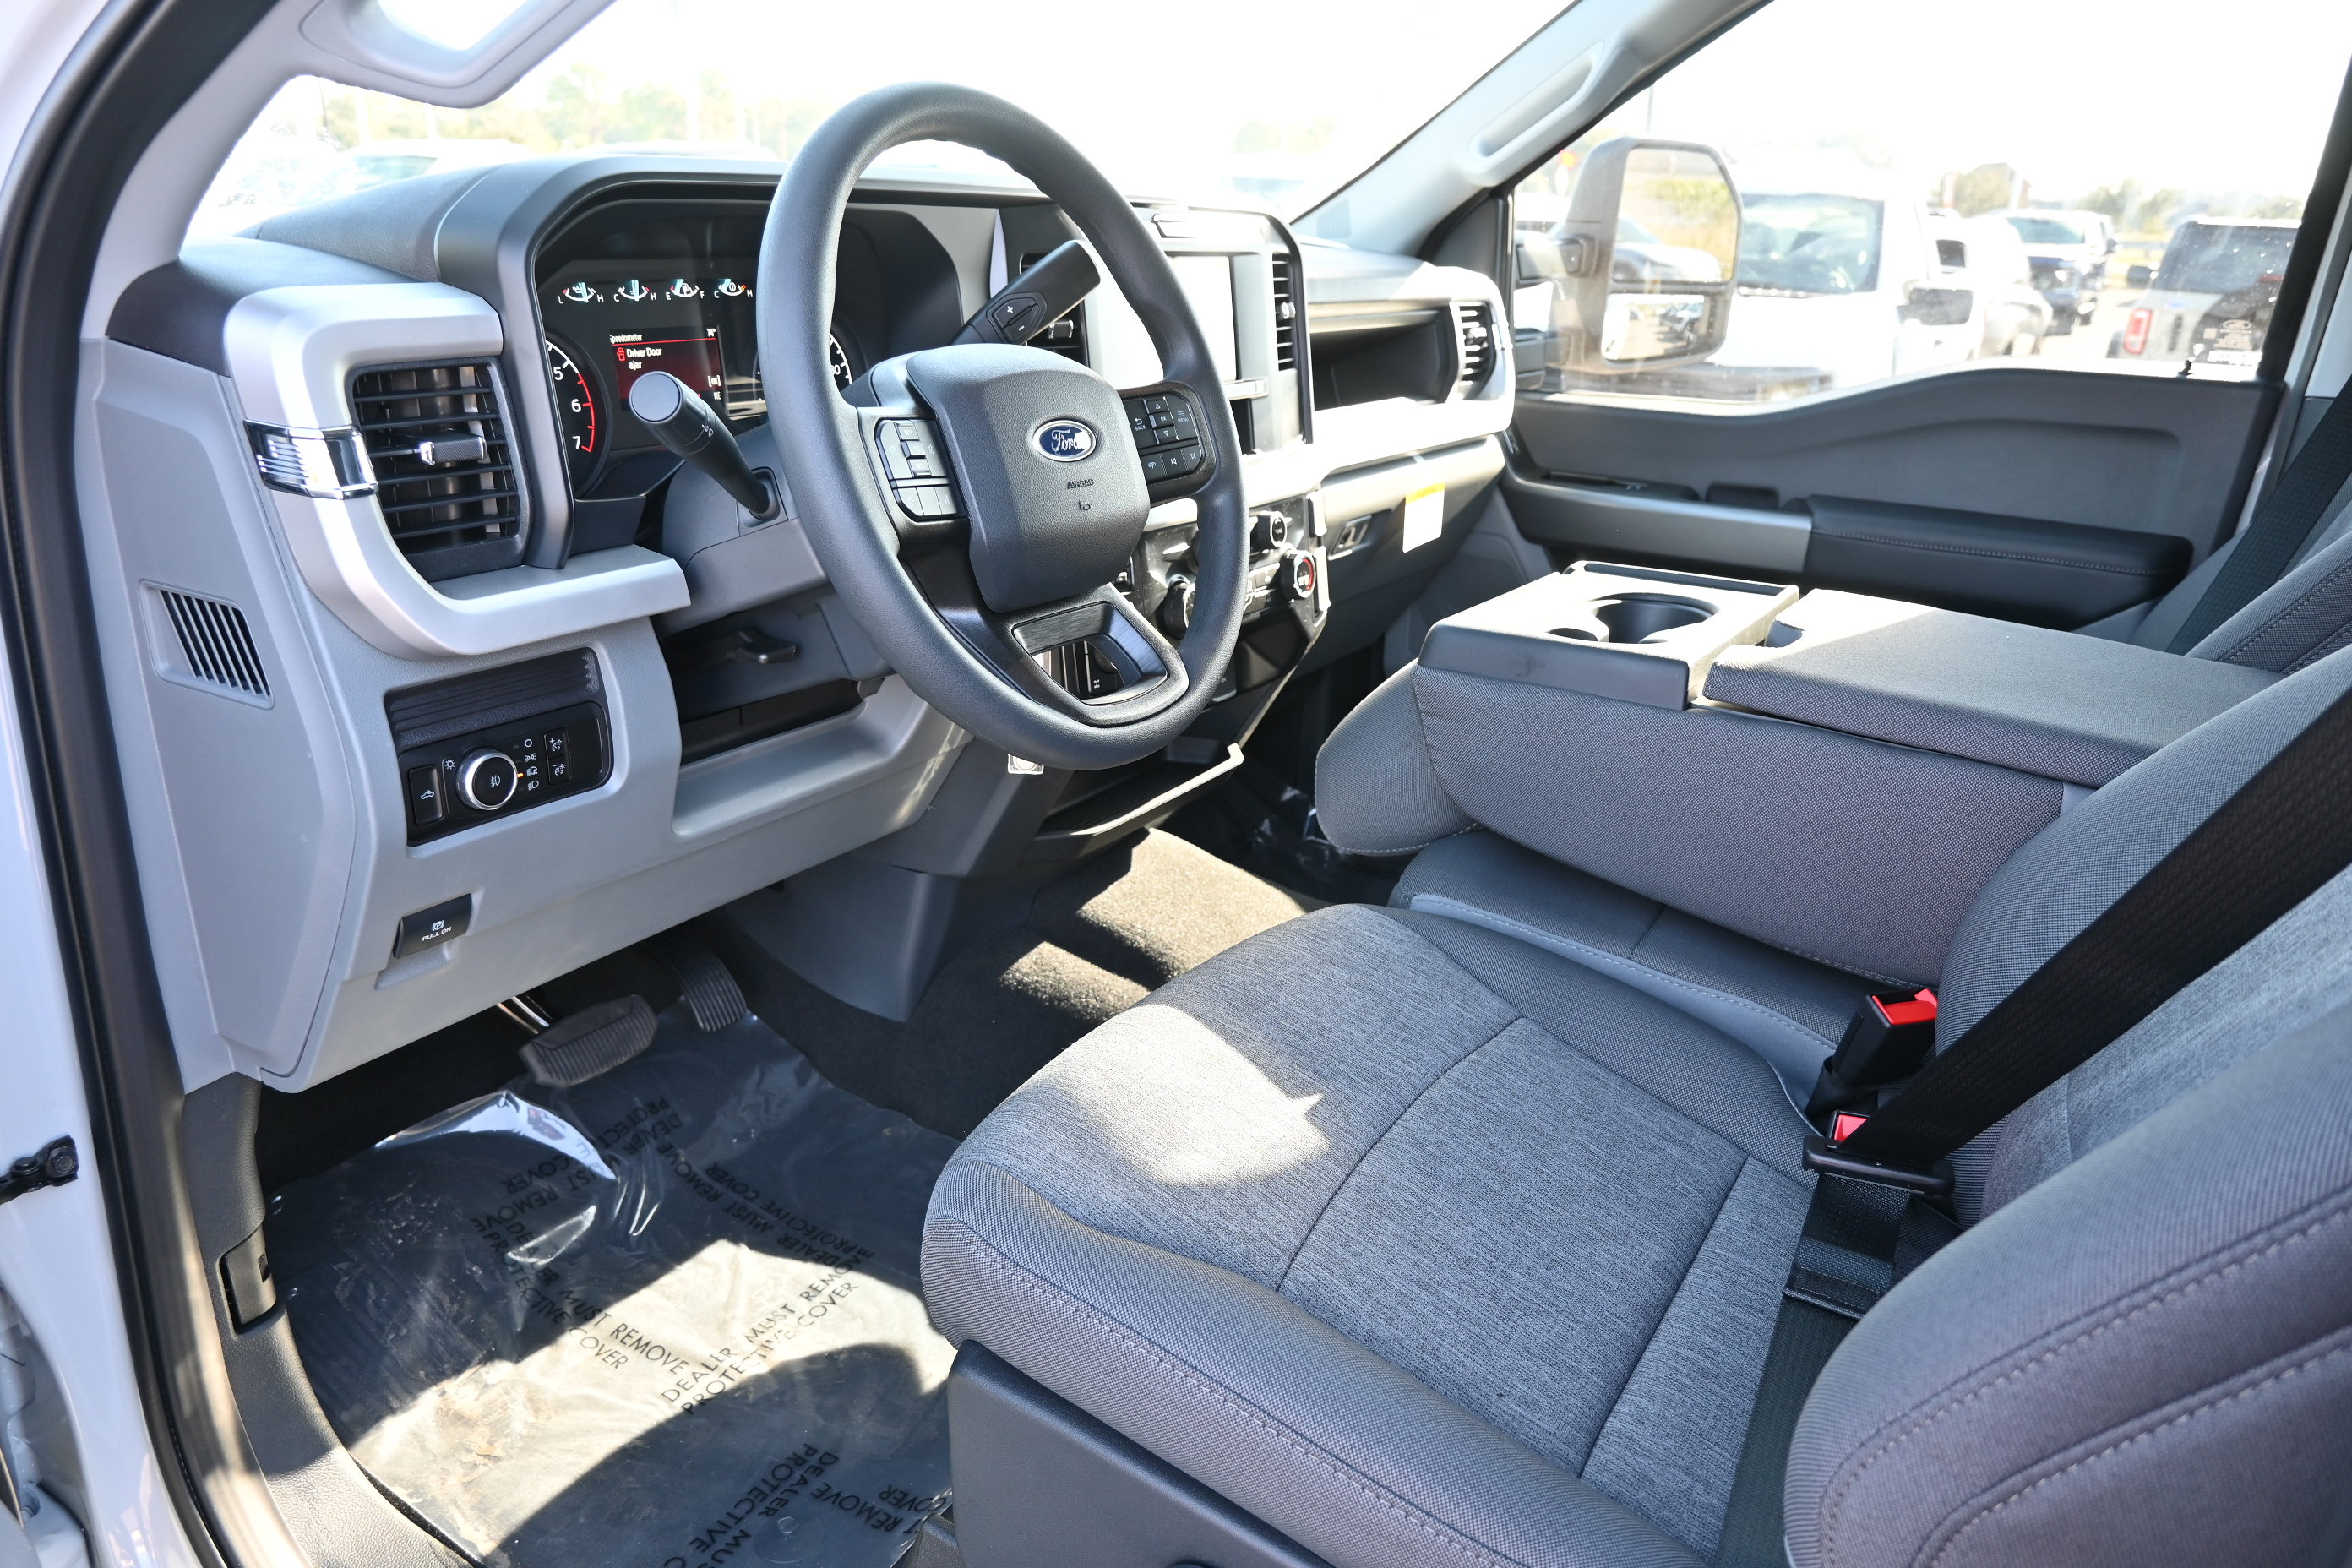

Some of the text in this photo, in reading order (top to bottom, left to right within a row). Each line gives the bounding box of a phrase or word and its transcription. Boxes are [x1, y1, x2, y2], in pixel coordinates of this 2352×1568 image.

[553, 366, 564, 380] 5
[626, 346, 662, 358] Driver Door
[629, 360, 642, 371] ajar
[571, 398, 582, 413] 6
[572, 435, 581, 449] 7
[1067, 478, 1094, 489] AIRBAG
[422, 926, 452, 942] PULL ON
[503, 1154, 572, 1195] COVER
[470, 1186, 558, 1234] REMOVE
[658, 1141, 838, 1267] DEALER MUST REMOVE
[705, 1162, 857, 1252] PROTECTIVE COVER
[482, 1229, 629, 1369] PROTECTIVE COVER
[558, 1289, 612, 1327] MUST
[611, 1322, 690, 1375] REMOVE
[661, 1250, 876, 1402] DEALER MUST REMOVE
[680, 1282, 859, 1416] PROTECTIVE COVER
[689, 1442, 819, 1553] PROTECTIVE
[758, 1451, 840, 1518] DEALER
[811, 1481, 904, 1533] REMOVE
[878, 1484, 949, 1512] COVER
